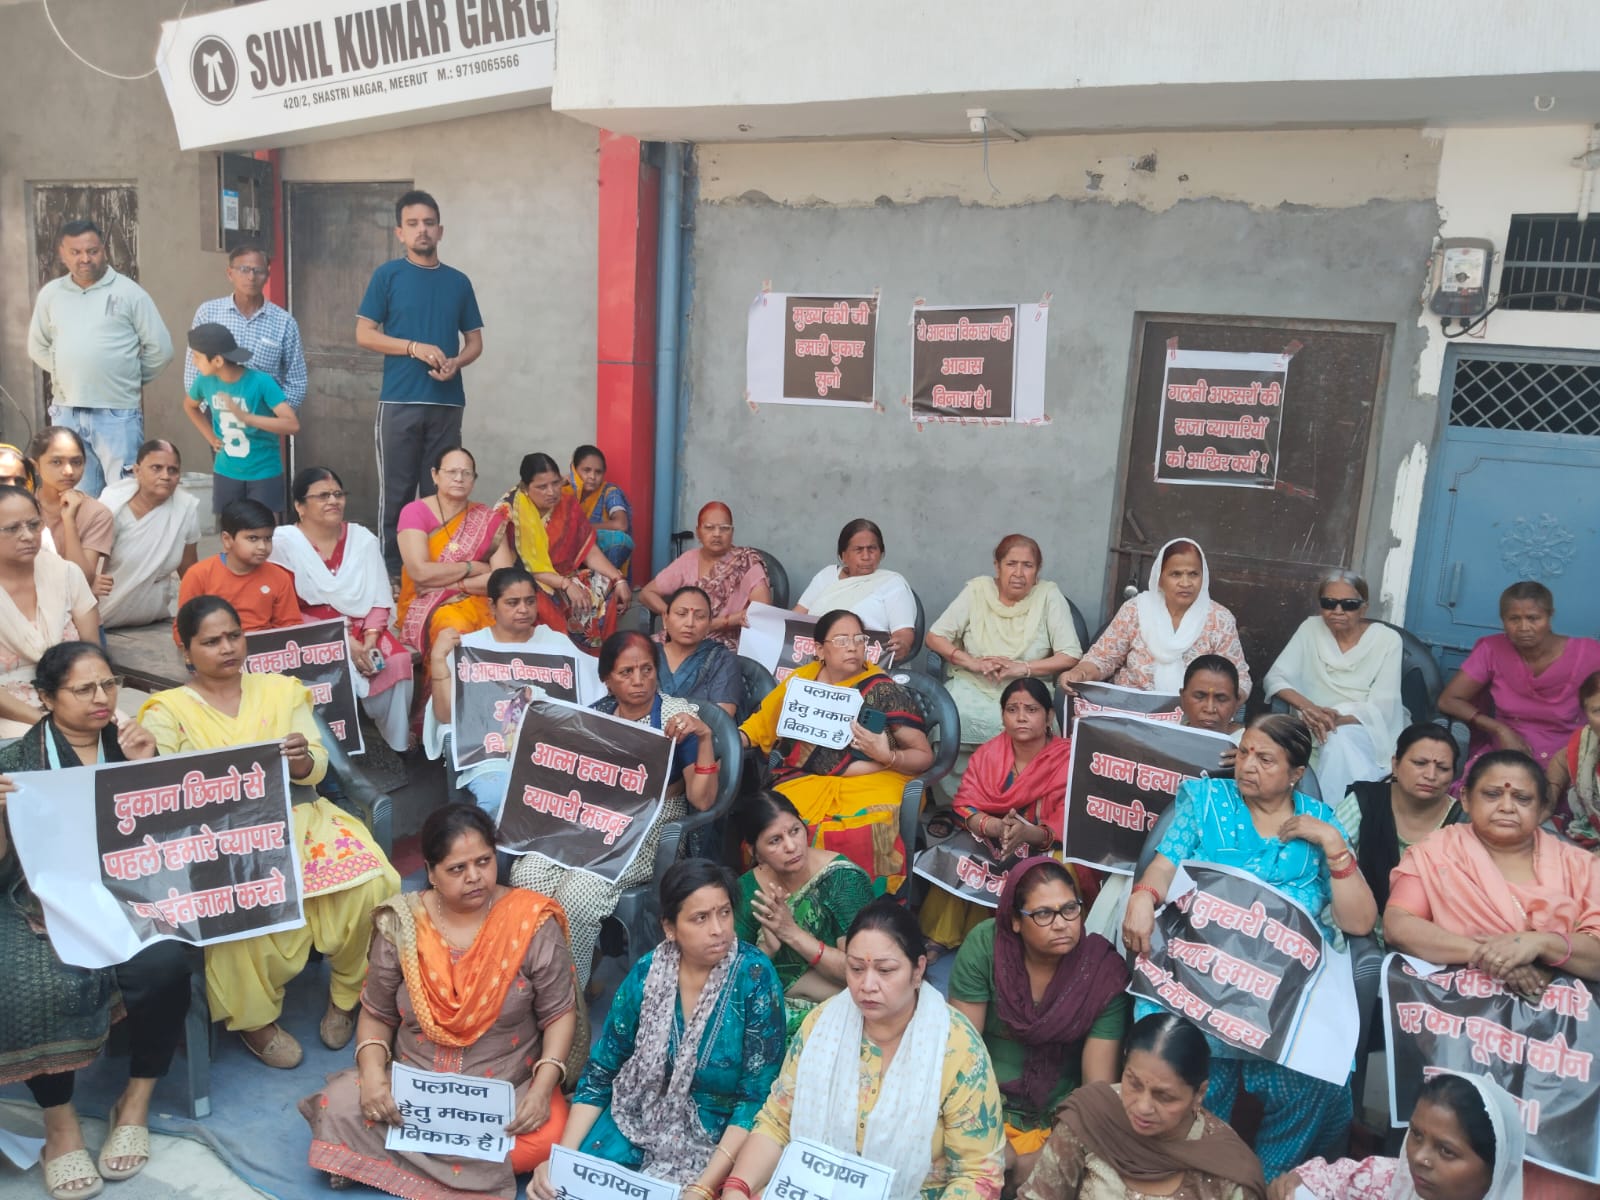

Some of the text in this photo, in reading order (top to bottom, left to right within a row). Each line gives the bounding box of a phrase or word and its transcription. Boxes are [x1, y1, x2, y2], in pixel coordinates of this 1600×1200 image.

[246, 0, 552, 91] SUNIL KUMAR GARG
[283, 94, 311, 110] 420/2,
[312, 87, 351, 105] SHASTRI
[353, 80, 387, 98] NAGAR,
[389, 71, 429, 91] MEERUT
[455, 53, 520, 79] 9719065566
[792, 301, 870, 332] मुख्य मंत्री जी
[927, 322, 957, 342] आवास
[958, 316, 990, 342] विकास
[795, 333, 866, 366] हमारी पुकार
[941, 356, 984, 376] आवास
[815, 366, 842, 396] सुनो
[1167, 378, 1282, 407] गलती अफसरों की
[1174, 414, 1270, 440] सजा व्यापारियों
[1166, 445, 1270, 474] को आखिर क्यों ?
[302, 640, 345, 664] गलत
[471, 661, 512, 682] आवास
[511, 658, 552, 683] विकास
[803, 684, 852, 703] पलायन
[788, 699, 856, 723] हेतु मकान
[783, 718, 830, 740] बिकाऊ
[531, 742, 577, 775] आत्म
[576, 753, 621, 787] हत्या
[620, 763, 648, 795] को
[1089, 751, 1183, 796] आत्म हत्या
[114, 761, 266, 835] दुकान छिनने से
[522, 784, 633, 845] व्यापारी मजबूर
[1086, 795, 1147, 832] व्यापारी
[103, 821, 286, 881] पहले हमारे व्यापार
[155, 886, 235, 929] इंतजाम
[235, 867, 287, 910] करते
[1190, 890, 1267, 939] तुम्हारी
[1263, 917, 1321, 971] गलत
[1211, 951, 1282, 1000] हमारा
[1207, 1008, 1271, 1049] नहस
[1396, 1002, 1594, 1082] घर का चूल्हा कौन
[412, 1078, 490, 1098] पलायन
[398, 1099, 504, 1125] हेतु मकान
[400, 1122, 471, 1147] बिकाऊ
[573, 1162, 651, 1200] पलायन
[801, 1150, 869, 1189] पलायन
